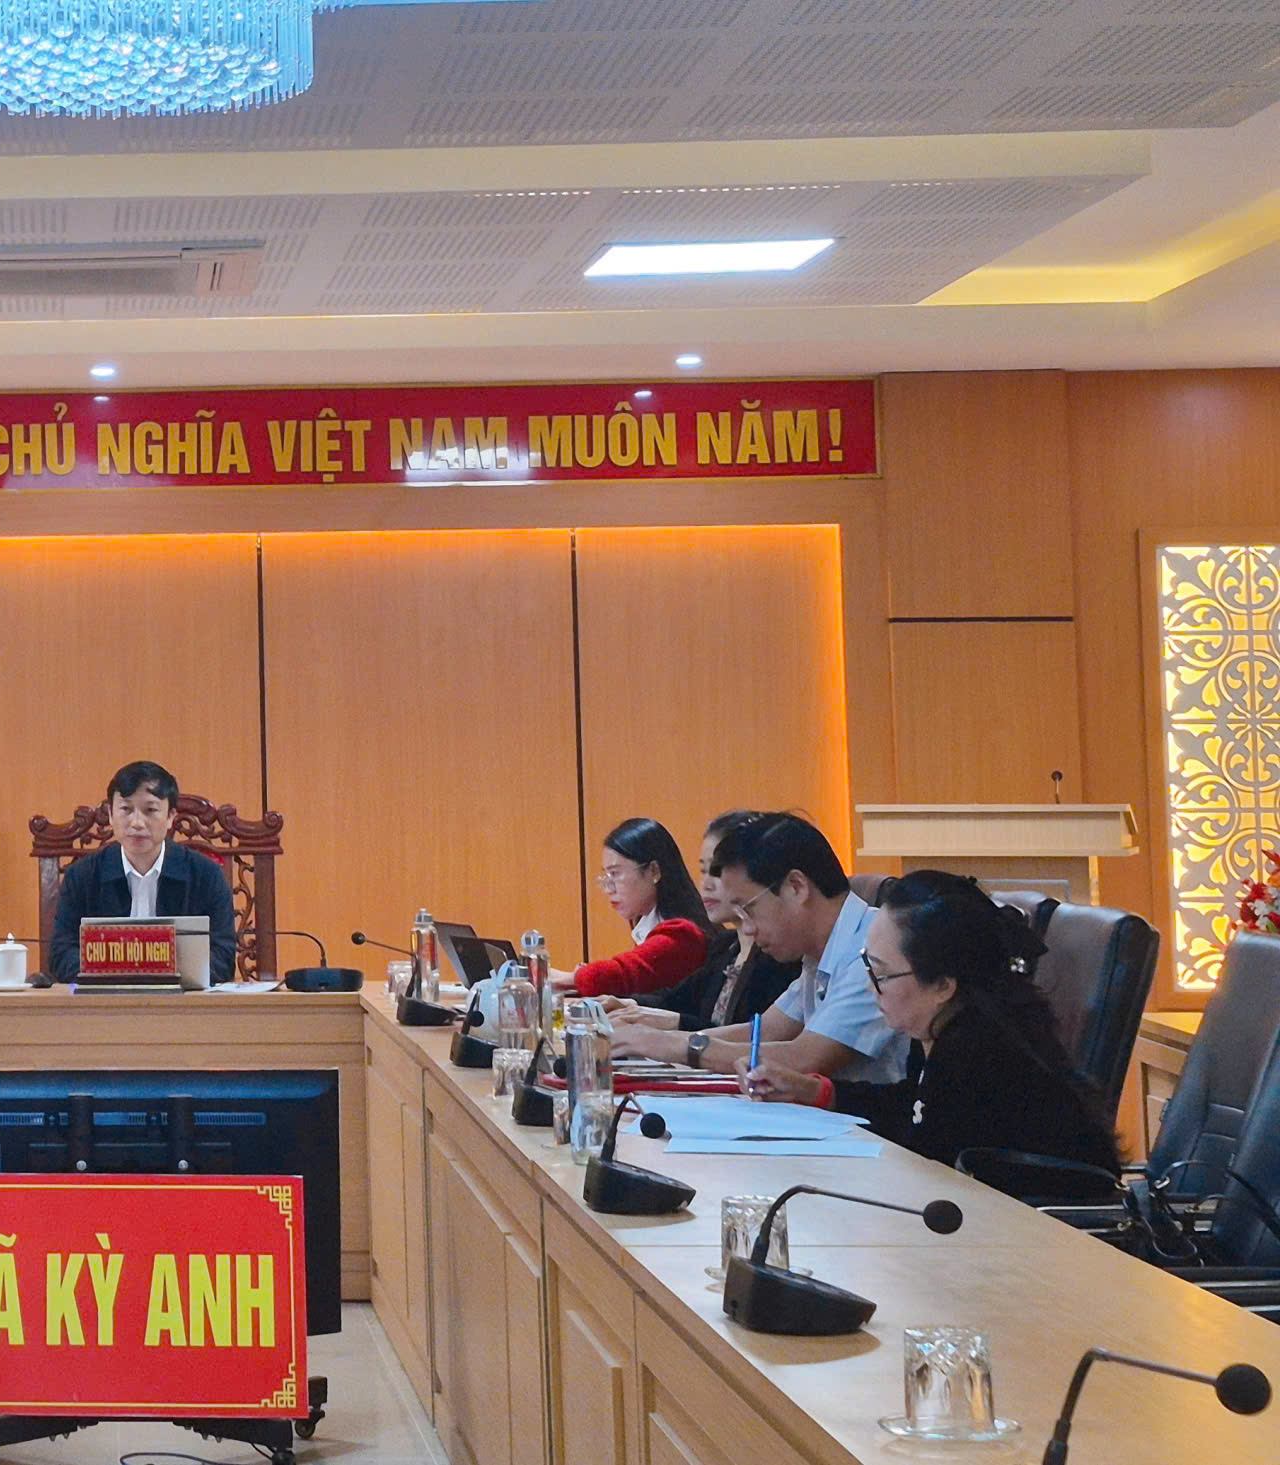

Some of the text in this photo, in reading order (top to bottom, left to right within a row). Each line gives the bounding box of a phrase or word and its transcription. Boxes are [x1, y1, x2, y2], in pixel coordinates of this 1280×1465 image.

[96, 410, 251, 475] NGHĨA
[267, 408, 371, 483] VIỆT
[390, 416, 510, 470] NAM
[527, 401, 679, 468] MUÔN
[86, 932, 170, 966] CHỦ TRÌ HỘI NGHỊ
[46, 1232, 125, 1347] KỲ
[143, 1253, 276, 1348] ANH
